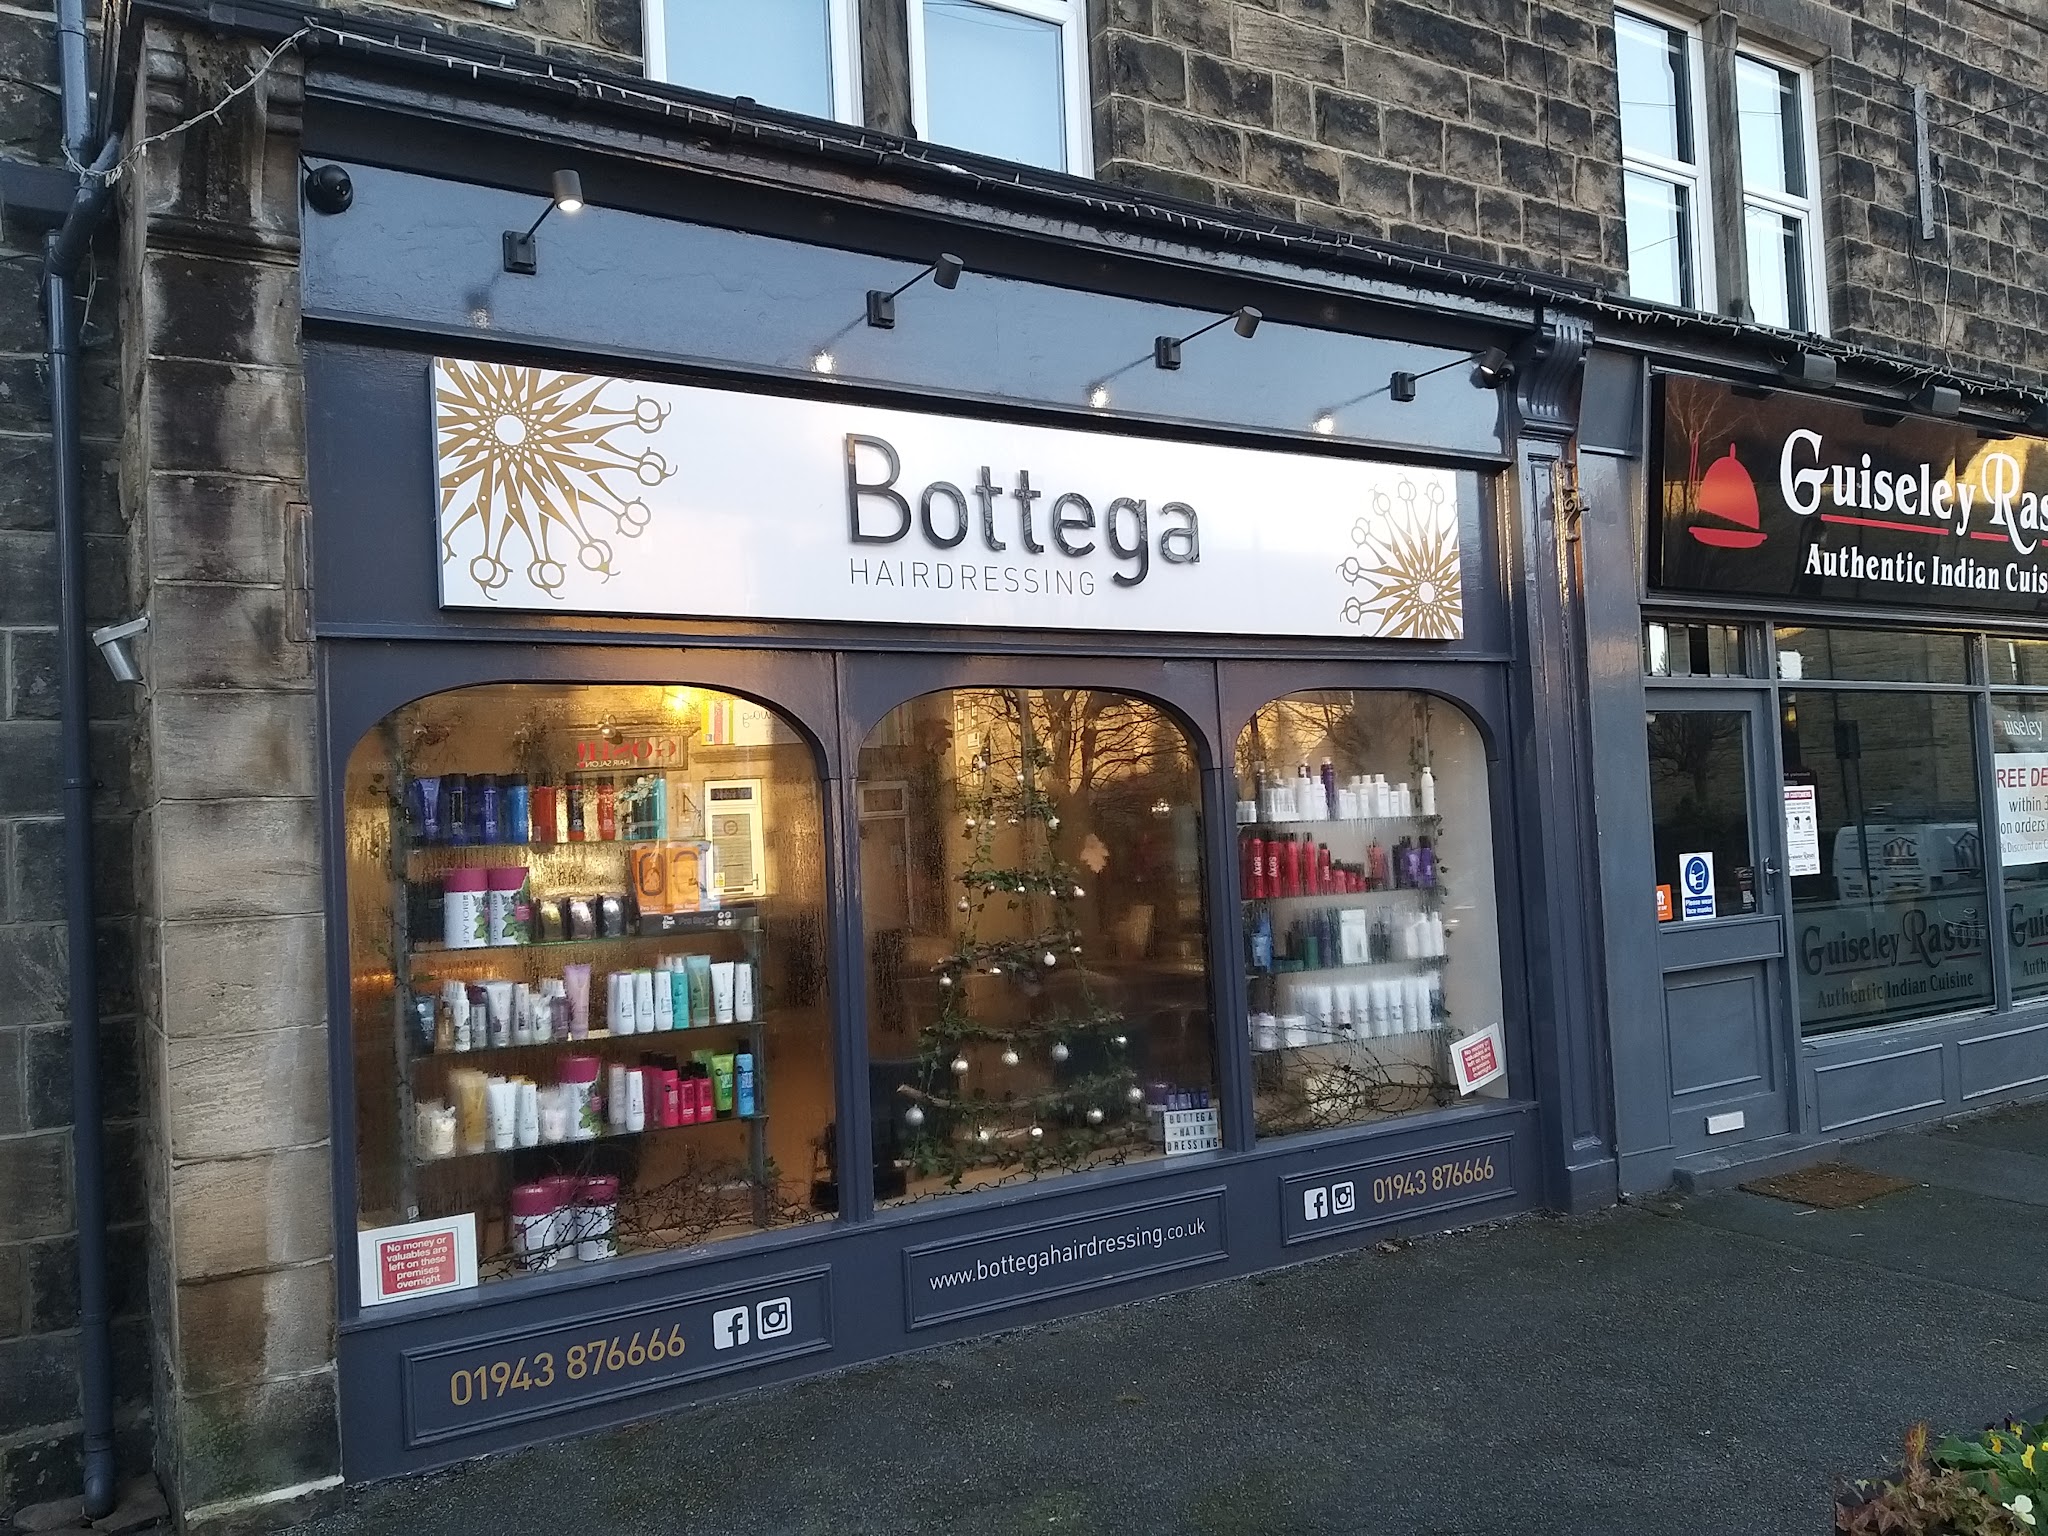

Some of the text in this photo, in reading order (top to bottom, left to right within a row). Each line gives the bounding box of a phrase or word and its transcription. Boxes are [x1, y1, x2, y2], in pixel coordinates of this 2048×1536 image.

[1780, 428, 1976, 536] Guiseley
[846, 432, 1200, 587] Bottega
[851, 558, 1095, 596] HAIRDRESSING
[1805, 543, 1926, 585] Authentic
[1932, 556, 2000, 590] Indian
[2008, 796, 2042, 812] within
[2000, 817, 2045, 834] on orders
[1253, 856, 1262, 877] sexy
[1801, 925, 1900, 976] Guiseley
[1817, 971, 1974, 1009] Authentic Indian Cuisine
[1169, 1112, 1213, 1124] BOTTEGA
[1167, 1137, 1218, 1152] DRESSING
[1373, 1169, 1426, 1204] 01943
[1431, 1156, 1494, 1191] 876666
[386, 1244, 401, 1253] No
[403, 1239, 435, 1250] money
[386, 1246, 448, 1262] valuables are
[929, 1217, 1206, 1290] www.bottegahairdressing.co.uk
[388, 1255, 447, 1271] left on these
[396, 1266, 440, 1281] premises
[396, 1274, 441, 1289] overnight
[450, 1353, 555, 1406] 01943
[566, 1323, 686, 1380] 876666
